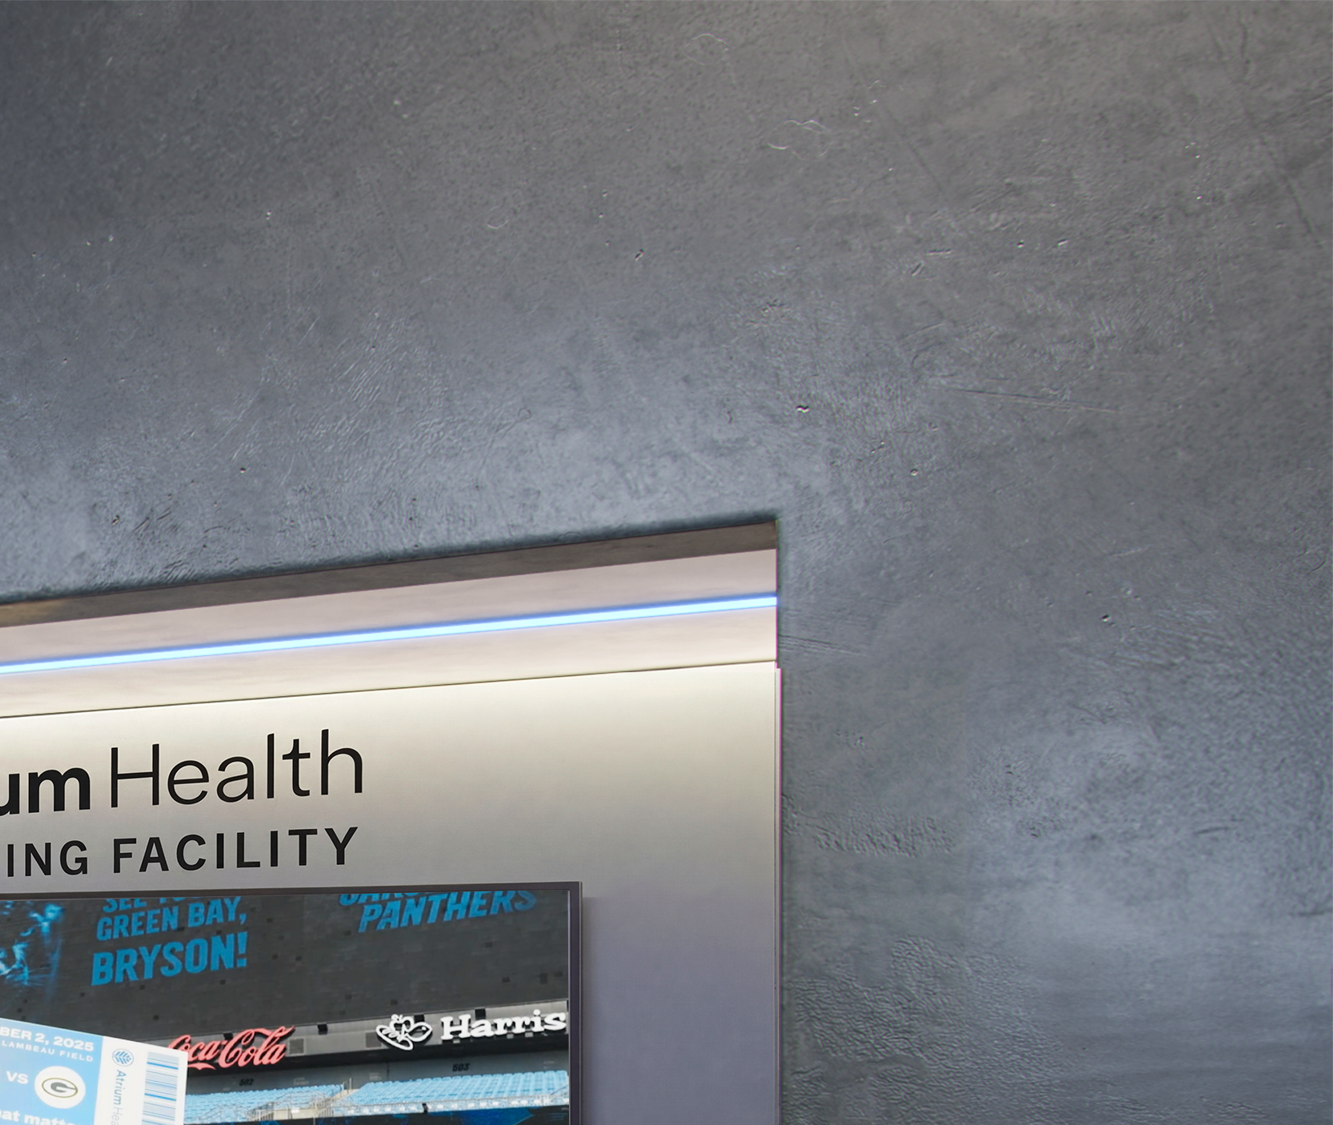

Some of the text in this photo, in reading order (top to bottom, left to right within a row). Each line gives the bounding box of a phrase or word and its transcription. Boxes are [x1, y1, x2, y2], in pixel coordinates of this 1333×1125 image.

[110, 729, 364, 807] Health
[112, 827, 358, 873] FACILITY
[96, 896, 247, 941] GREEN BAY,
[358, 890, 537, 933] PANTHERS
[91, 932, 248, 986] BRYSON!
[34, 1033, 50, 1046] 2,
[53, 1036, 94, 1052] 2025
[440, 1009, 567, 1041] Harris
[2, 1039, 55, 1056] LAMBEAU
[59, 1050, 94, 1062] FIELD
[6, 1070, 29, 1085] VS
[114, 1069, 126, 1105] Atrium
